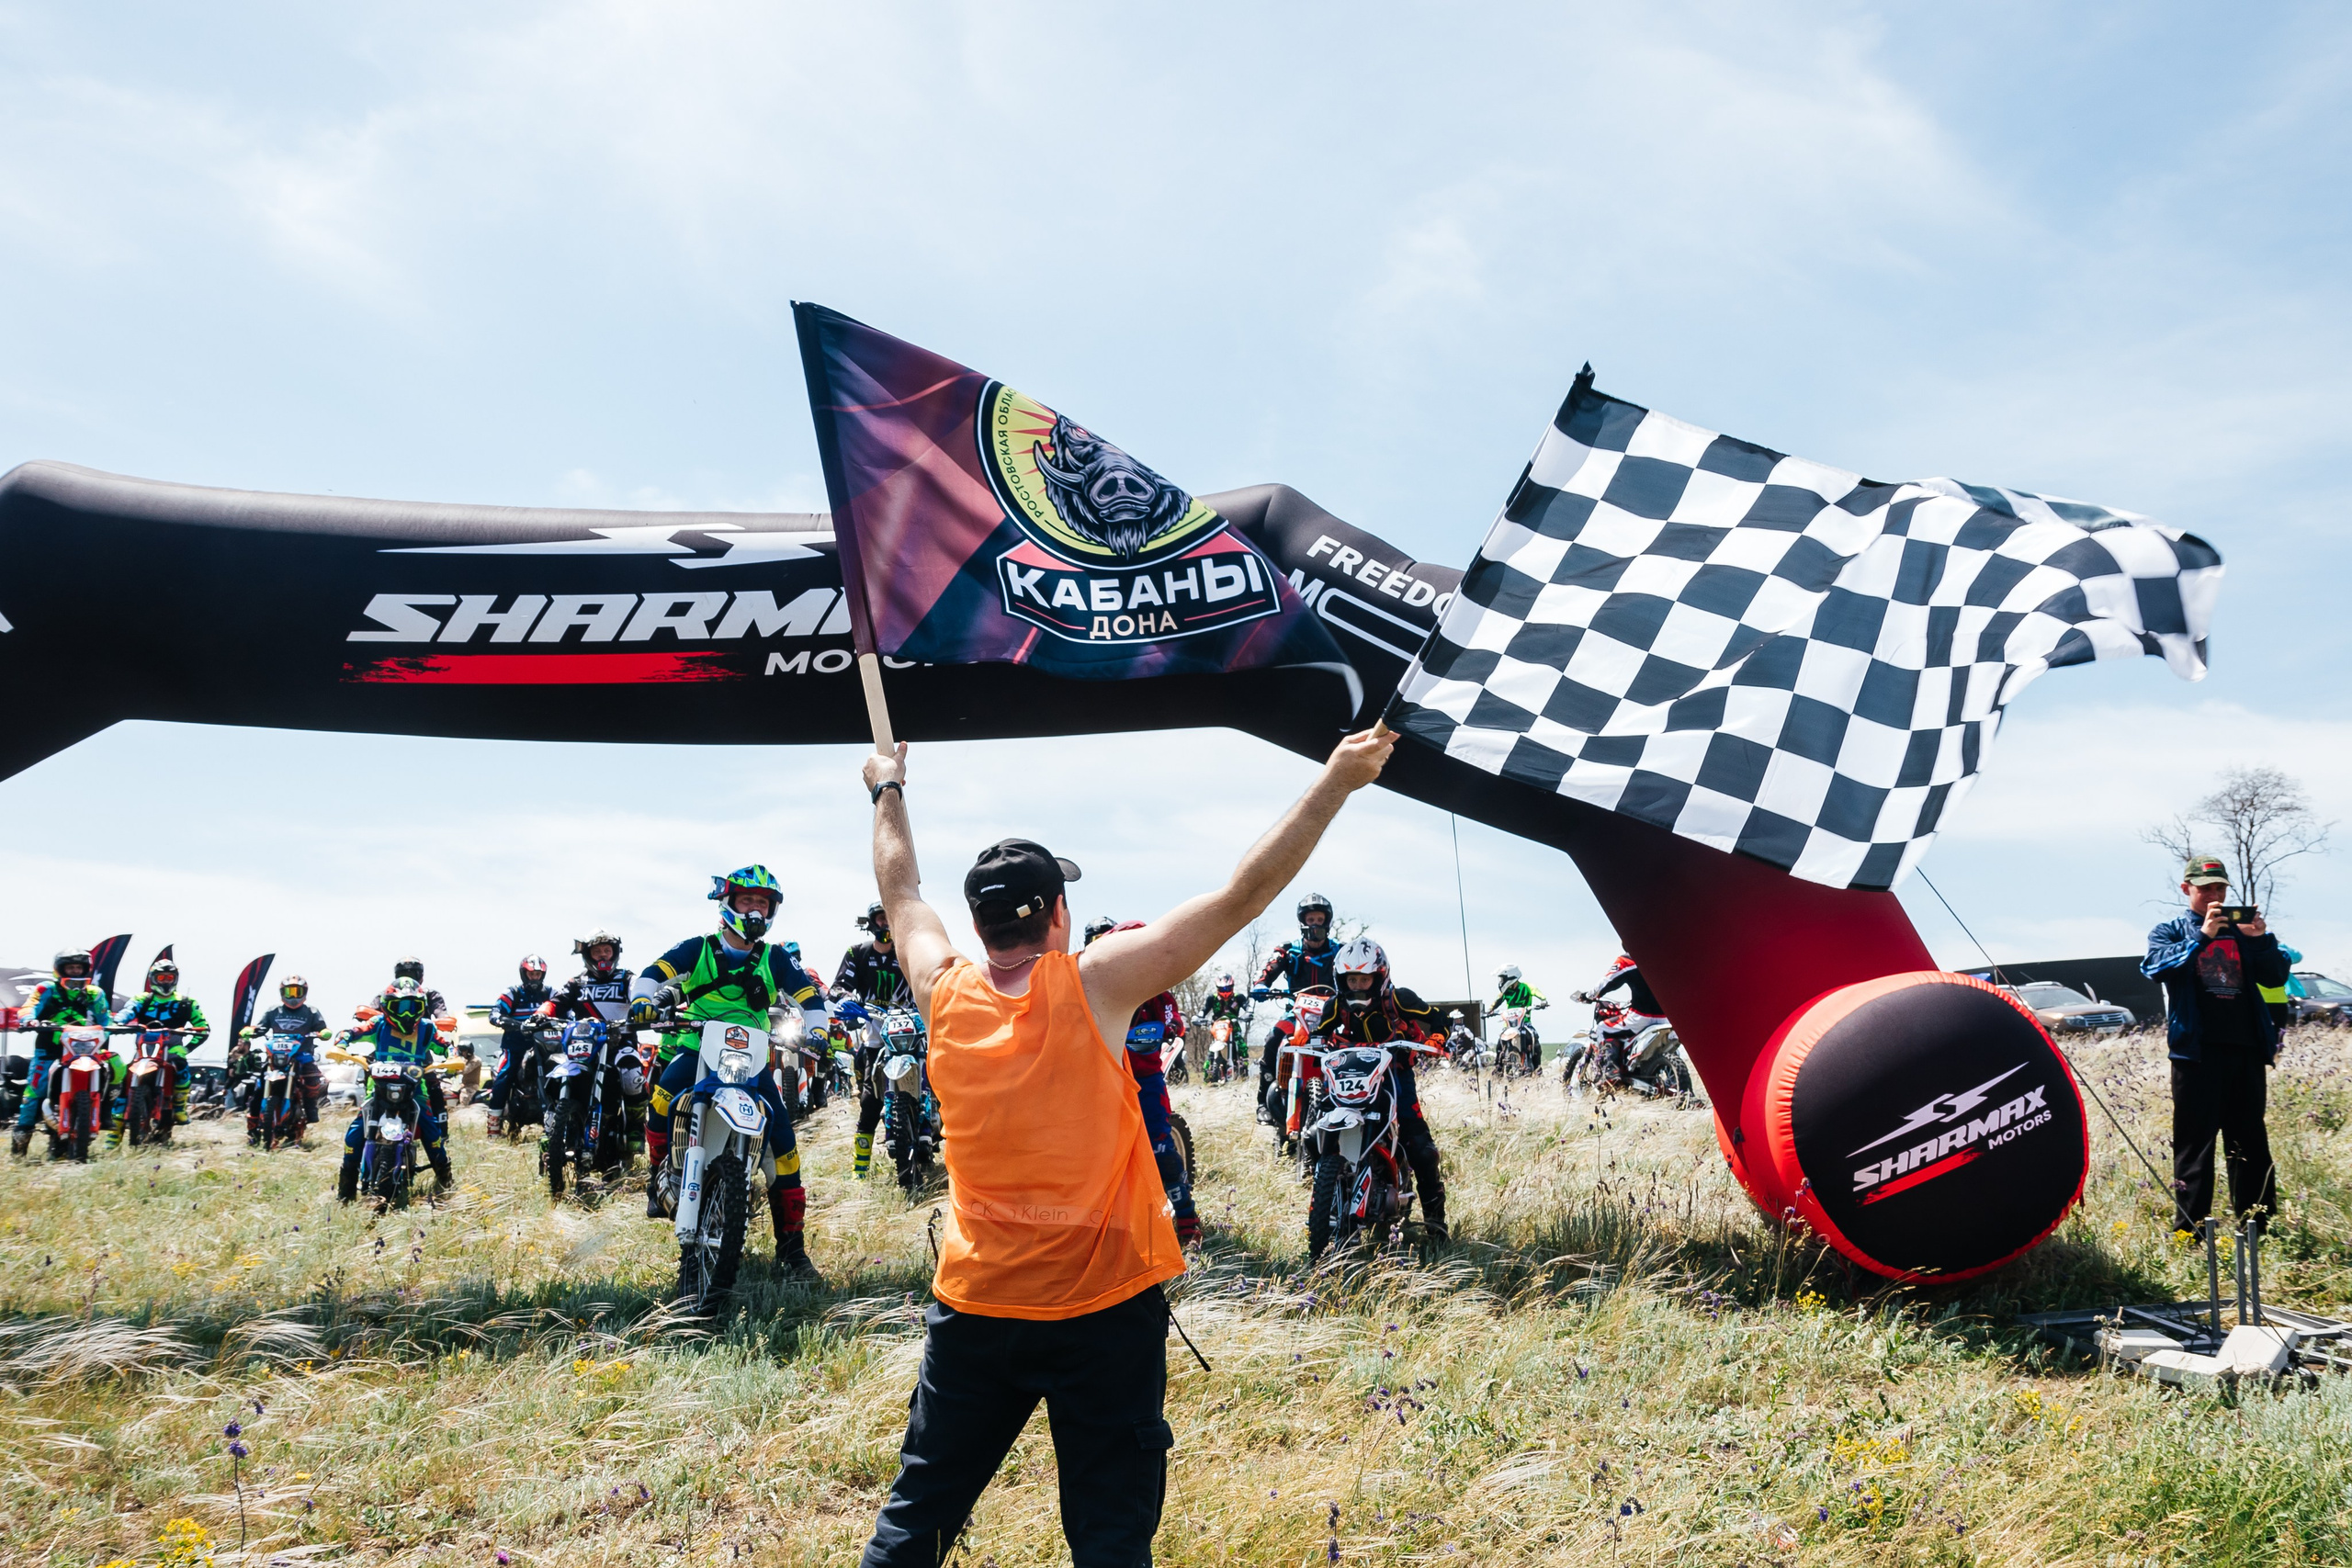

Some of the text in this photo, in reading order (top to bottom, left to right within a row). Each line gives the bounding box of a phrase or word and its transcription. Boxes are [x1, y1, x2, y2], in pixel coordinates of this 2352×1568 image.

[998, 429, 1045, 519] РОСТОВСКАЯ
[1006, 554, 1264, 612] КАБАНЫ
[1306, 534, 1456, 617] FREEDO
[345, 587, 853, 642] SHARM
[1089, 610, 1179, 640] ДОНА
[1303, 998, 1319, 1008] 125
[892, 1021, 910, 1029] 137
[571, 1044, 589, 1053] 145
[1339, 1079, 1365, 1092] 124
[1852, 1084, 2048, 1193] SHARMAX
[1987, 1109, 2052, 1151] MOTORS
[1022, 1204, 1069, 1222] Klein
